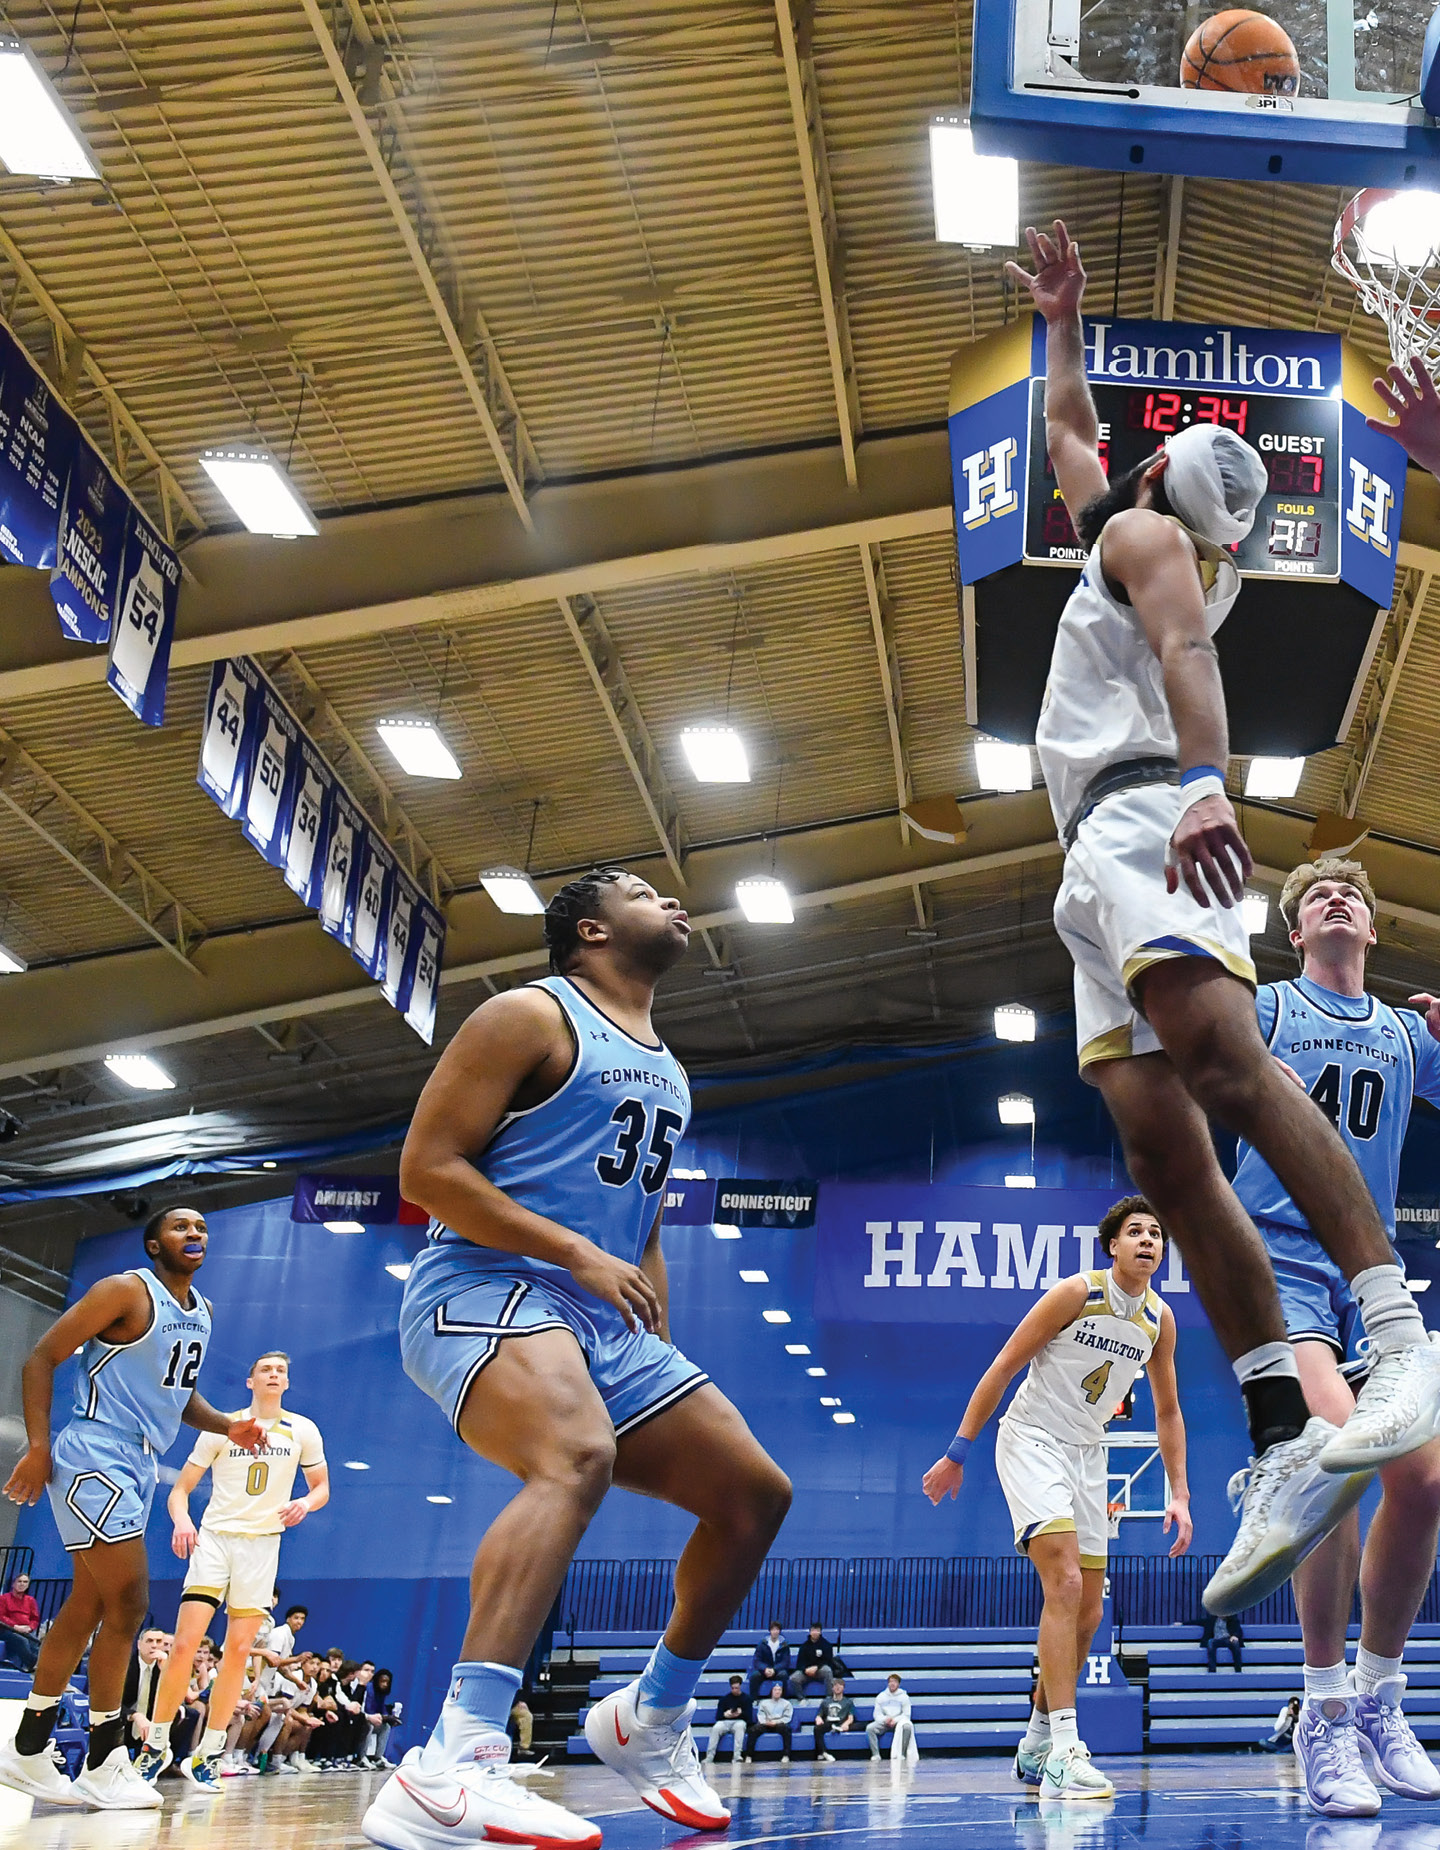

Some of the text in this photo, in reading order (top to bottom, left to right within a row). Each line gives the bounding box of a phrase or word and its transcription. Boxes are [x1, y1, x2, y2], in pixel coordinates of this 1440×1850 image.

[1083, 323, 1326, 391] Hamilton
[20, 415, 46, 453] NCAA
[1143, 393, 1249, 436] 12:34
[1258, 433, 1326, 455] GUEST
[962, 436, 1018, 531] H
[1276, 503, 1315, 516] FOULS
[1345, 456, 1395, 559] H
[75, 508, 103, 555] 2023
[66, 527, 108, 597] NESCAC
[1050, 547, 1091, 560] POINTS
[1274, 560, 1315, 573] POINTS
[129, 589, 160, 646] 54
[216, 701, 241, 748] 44
[259, 751, 282, 798] 50
[297, 800, 319, 844] 34
[363, 886, 381, 920] 40
[1290, 1037, 1399, 1068] CONNECTICUT
[1307, 1062, 1386, 1142] 40
[594, 1096, 684, 1197] 35
[314, 1189, 381, 1206] AMHERST
[721, 1193, 812, 1211] CONNECTICUT
[160, 1338, 203, 1391] 12
[1072, 1329, 1146, 1362] HAMILTON
[1080, 1359, 1115, 1406] 4
[245, 1461, 270, 1496] 0
[1085, 1655, 1112, 1685] H
